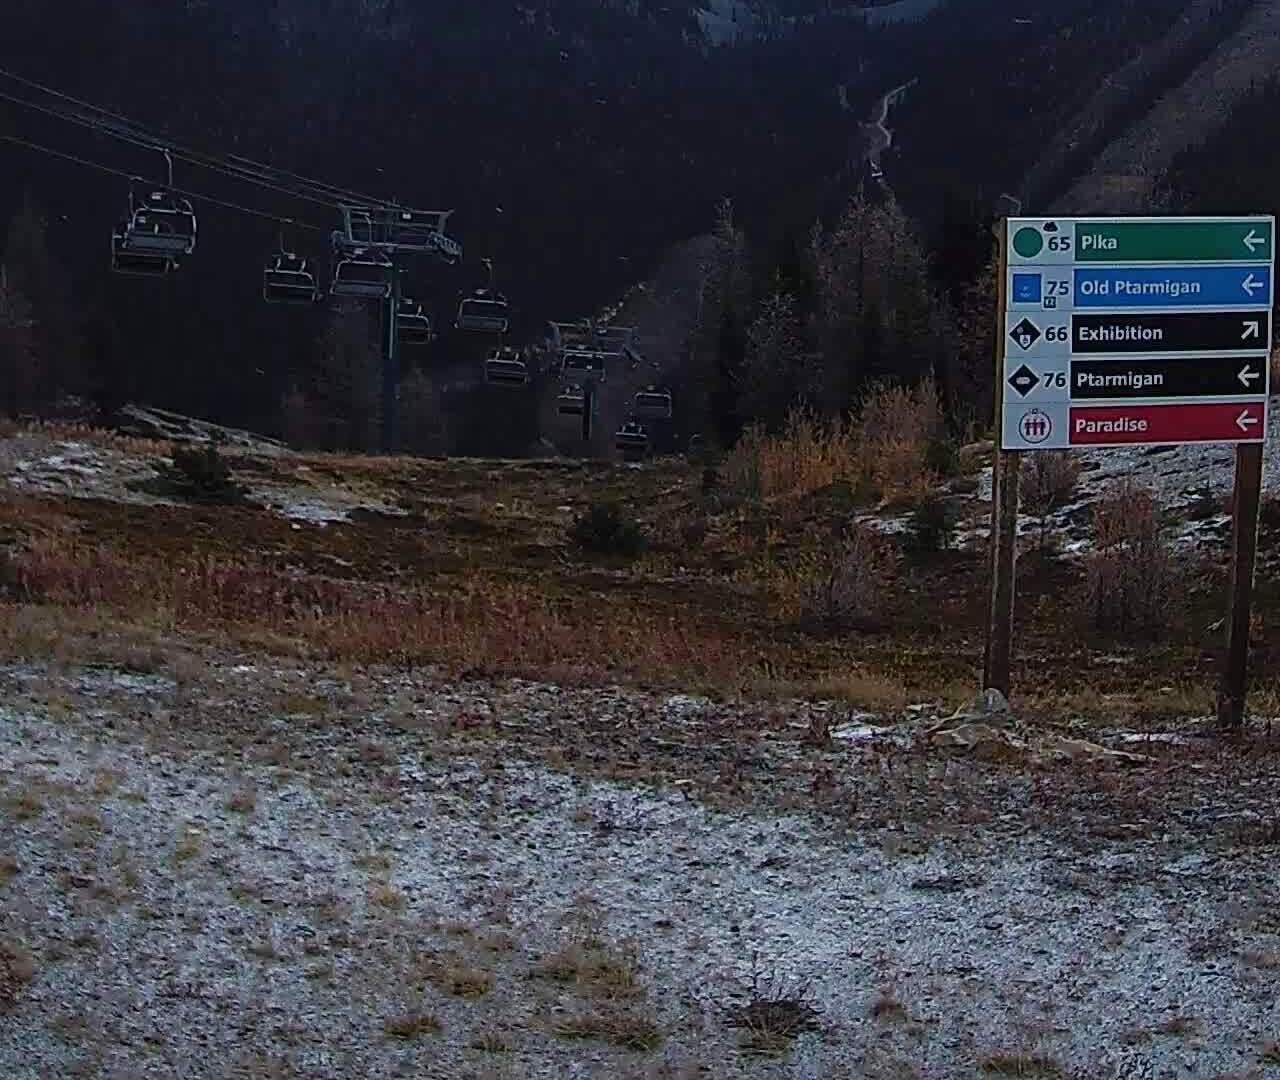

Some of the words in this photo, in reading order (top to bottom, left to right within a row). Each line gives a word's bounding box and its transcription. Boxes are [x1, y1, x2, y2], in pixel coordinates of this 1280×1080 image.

[1047, 236, 1071, 252] 65
[1081, 235, 1118, 250] Pika
[1047, 280, 1069, 296] 75
[1080, 280, 1109, 296] Old
[1114, 278, 1201, 299] Ptarmigan
[1045, 326, 1068, 342] 66
[1079, 324, 1163, 342] Exhibition
[1043, 372, 1066, 388] 76
[1076, 371, 1164, 389] Ptarmigan
[1075, 417, 1148, 433] Paradise
